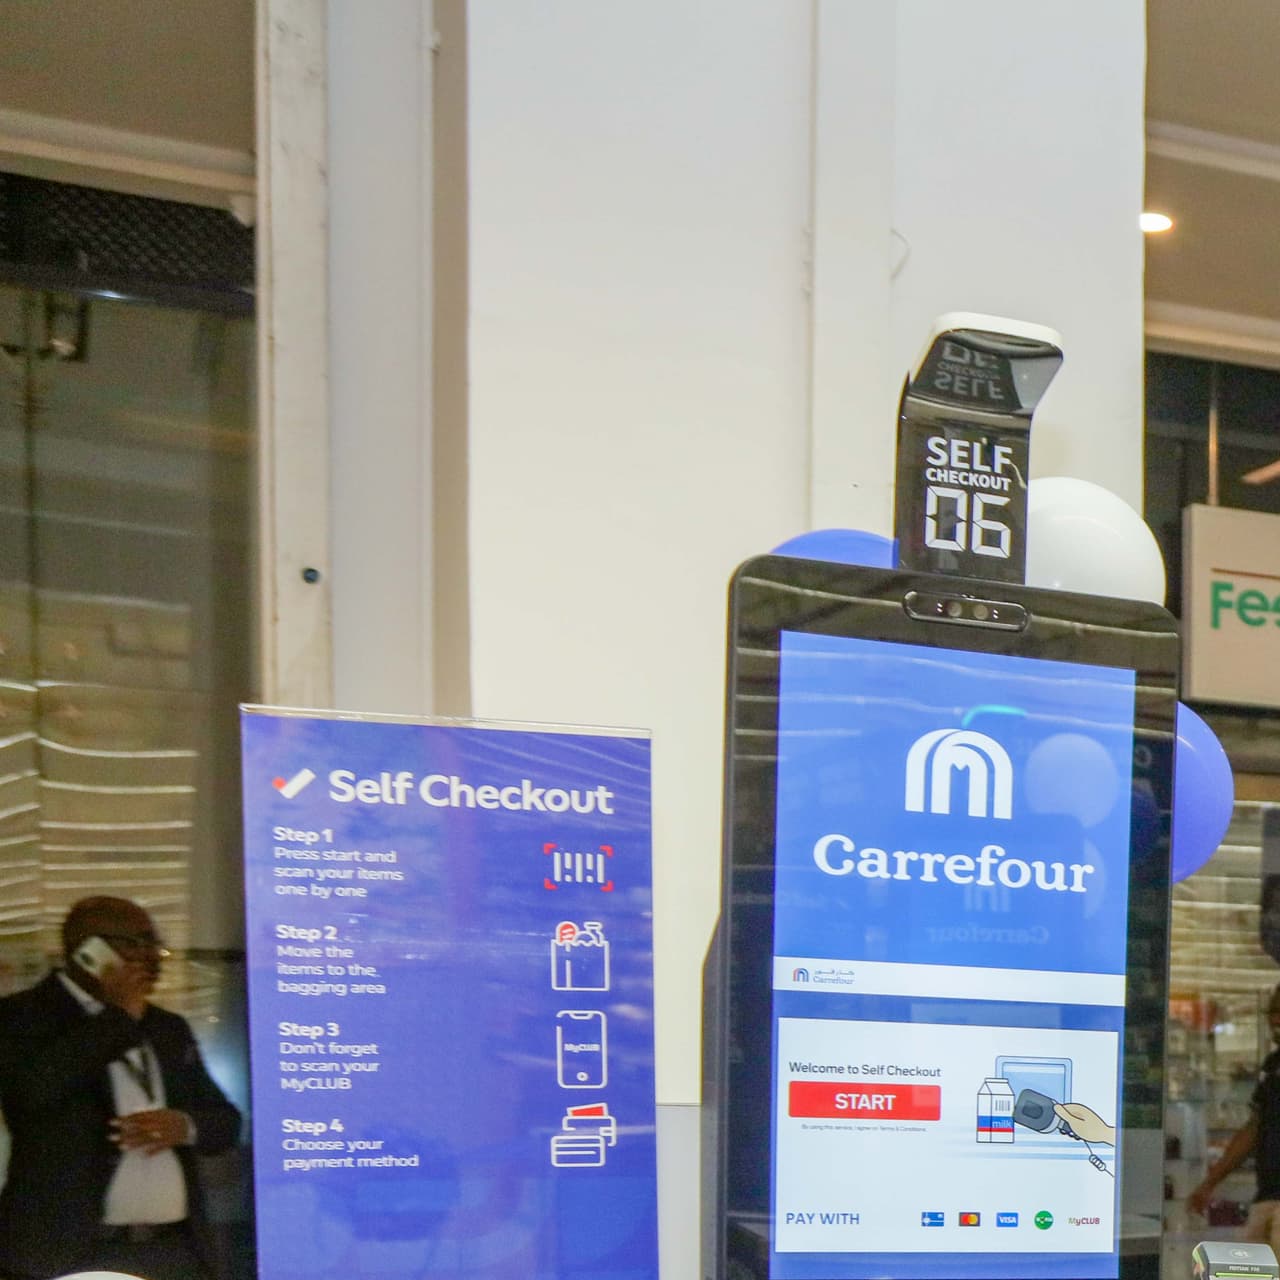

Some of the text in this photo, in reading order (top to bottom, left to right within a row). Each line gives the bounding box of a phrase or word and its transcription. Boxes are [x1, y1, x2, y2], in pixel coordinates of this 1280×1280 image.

[926, 436, 1012, 474] SELF
[926, 468, 1012, 491] CHECKOUT
[925, 485, 1011, 559] 06
[329, 770, 614, 814] Self Checkout
[273, 826, 333, 845] Step 1
[275, 846, 396, 863] Press start and
[813, 834, 1095, 893] Carrefour
[275, 865, 404, 883] scan your items
[275, 883, 367, 899] one by one
[277, 924, 337, 942] Step 2
[277, 945, 353, 959] Move the
[277, 963, 376, 978] items to the
[278, 980, 385, 997] bagging area
[279, 1022, 339, 1039] Step 3
[280, 1041, 378, 1057] Don't forget
[281, 1060, 379, 1076] to scan your
[789, 1062, 941, 1077] Welcome to Self Checkout
[281, 1076, 351, 1092] MyCLUB
[834, 1093, 896, 1110] START
[283, 1119, 343, 1136] Step 4
[283, 1137, 383, 1154] Choose your
[283, 1154, 418, 1171] payment method
[786, 1212, 860, 1225] PAY WITH
[1068, 1216, 1100, 1225] MyCLUB
